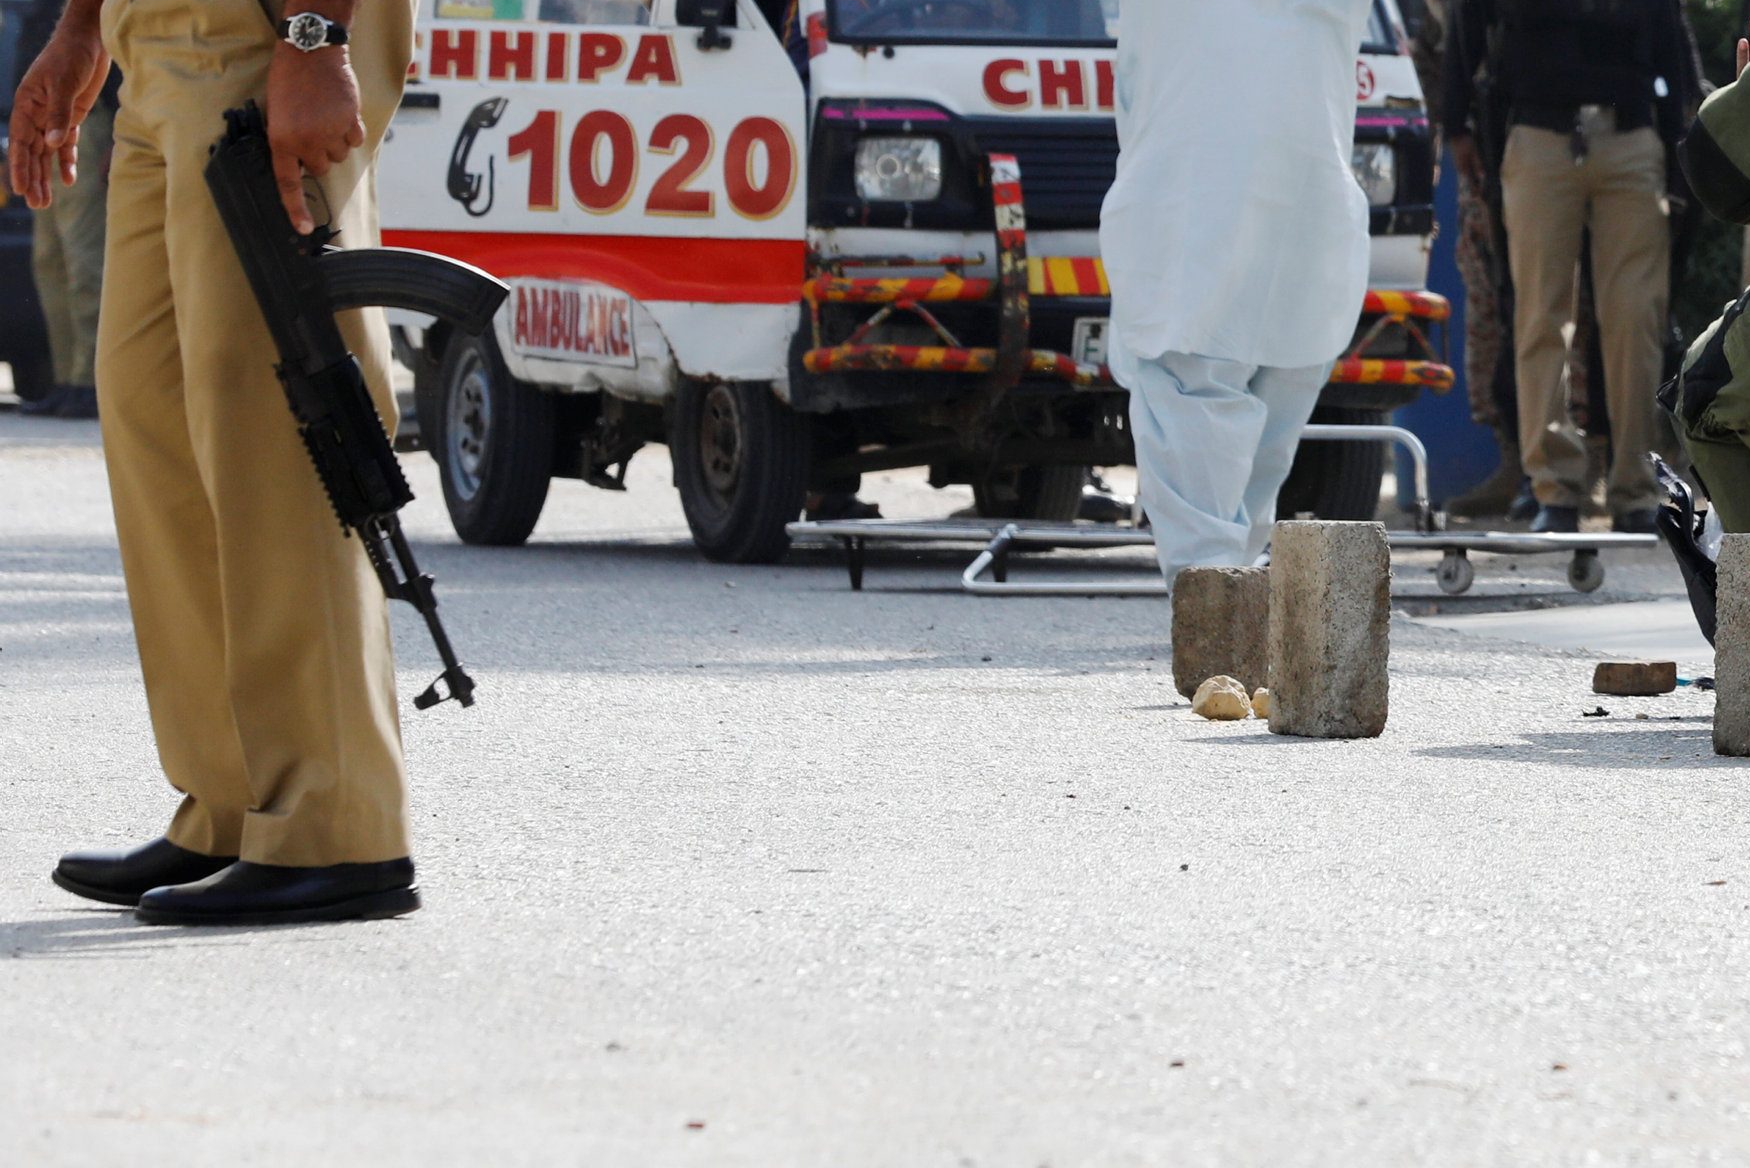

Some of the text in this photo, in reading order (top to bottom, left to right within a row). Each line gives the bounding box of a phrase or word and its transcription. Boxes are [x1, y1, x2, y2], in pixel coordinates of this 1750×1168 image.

[405, 29, 682, 85] HHIPA
[507, 109, 798, 221] 1020
[515, 286, 631, 357] AMBULANCE
